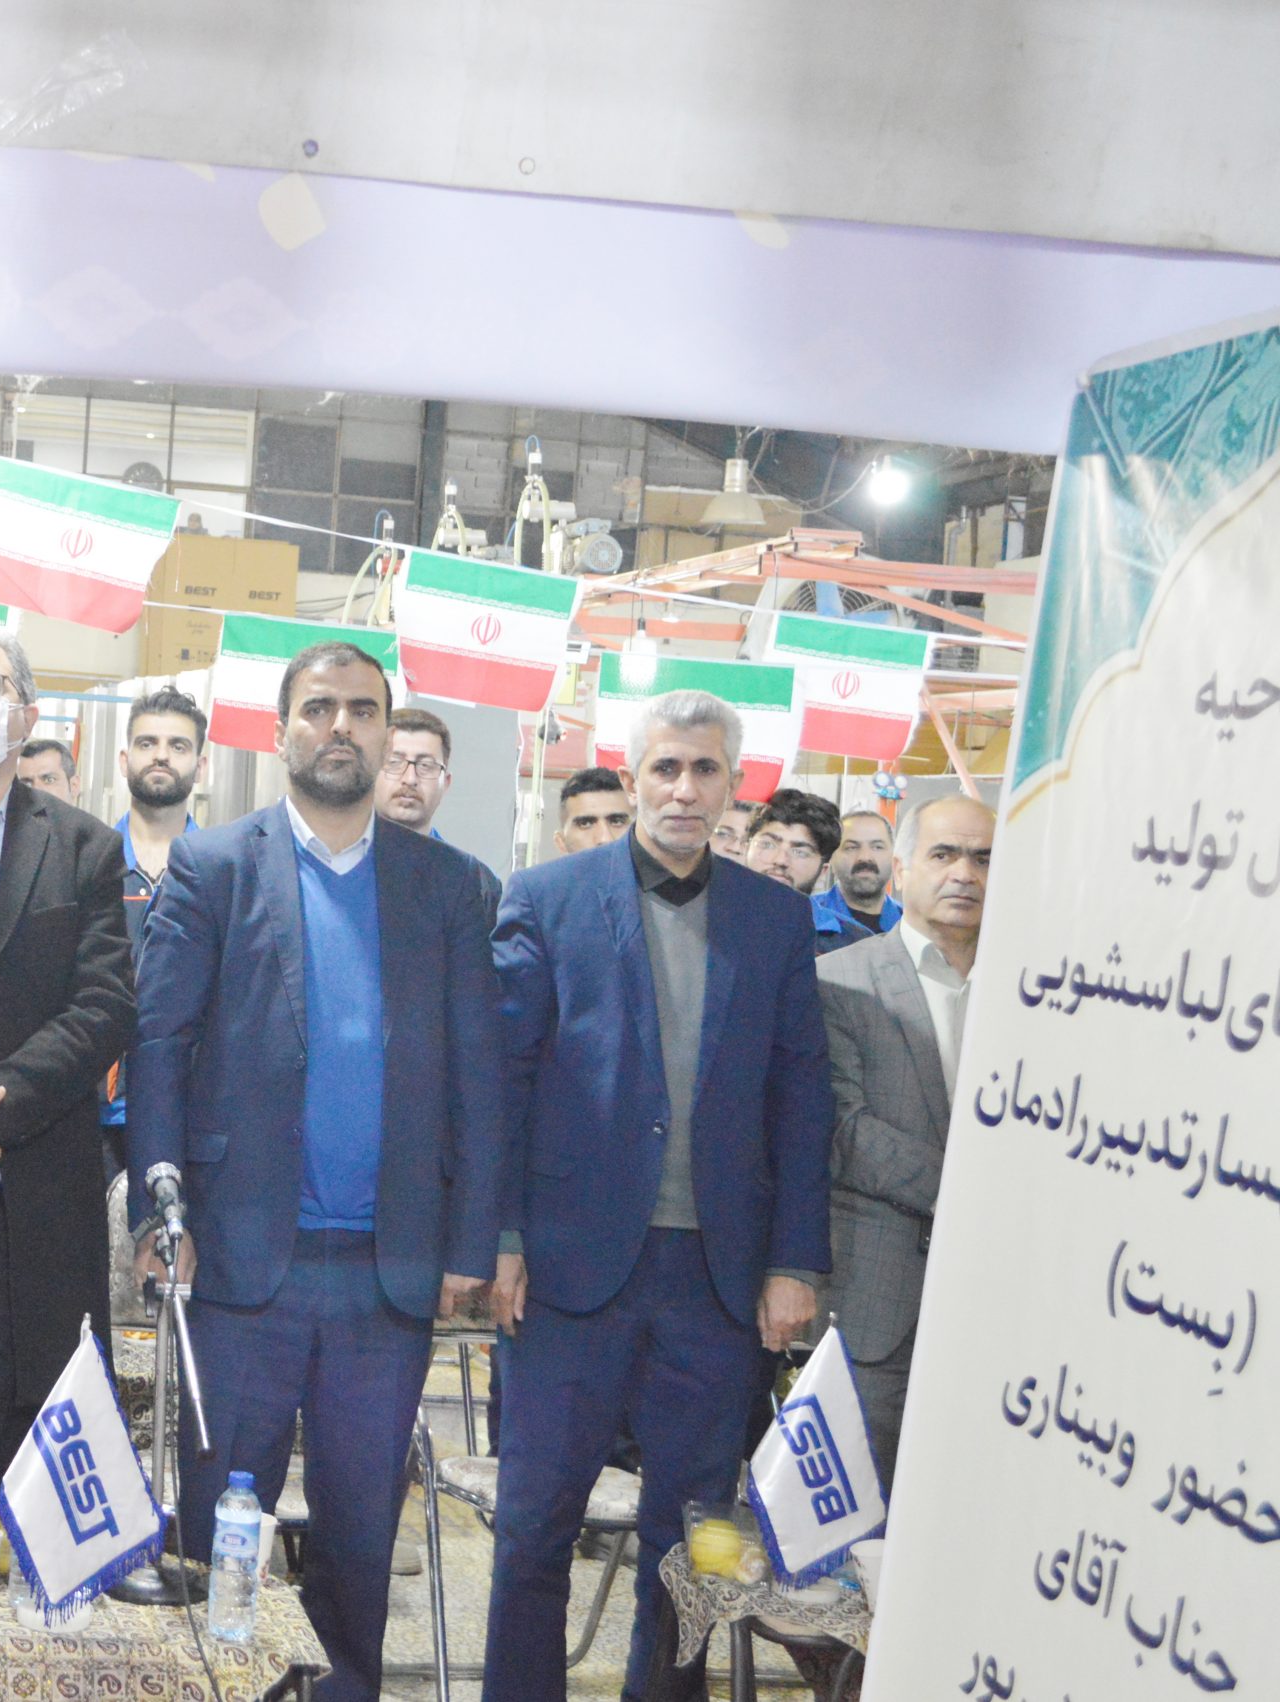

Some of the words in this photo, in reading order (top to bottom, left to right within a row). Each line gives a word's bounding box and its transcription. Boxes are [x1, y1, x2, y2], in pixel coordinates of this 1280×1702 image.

[184, 585, 217, 597] BEST
[248, 590, 282, 601] BEST
[1131, 798, 1245, 891] تولید
[1017, 940, 1231, 1042] لباسشویی
[1002, 1363, 1136, 1488] وبیناری
[32, 1398, 120, 1546] BEST
[1151, 1459, 1280, 1544] حضور
[1034, 1529, 1127, 1618] آقای
